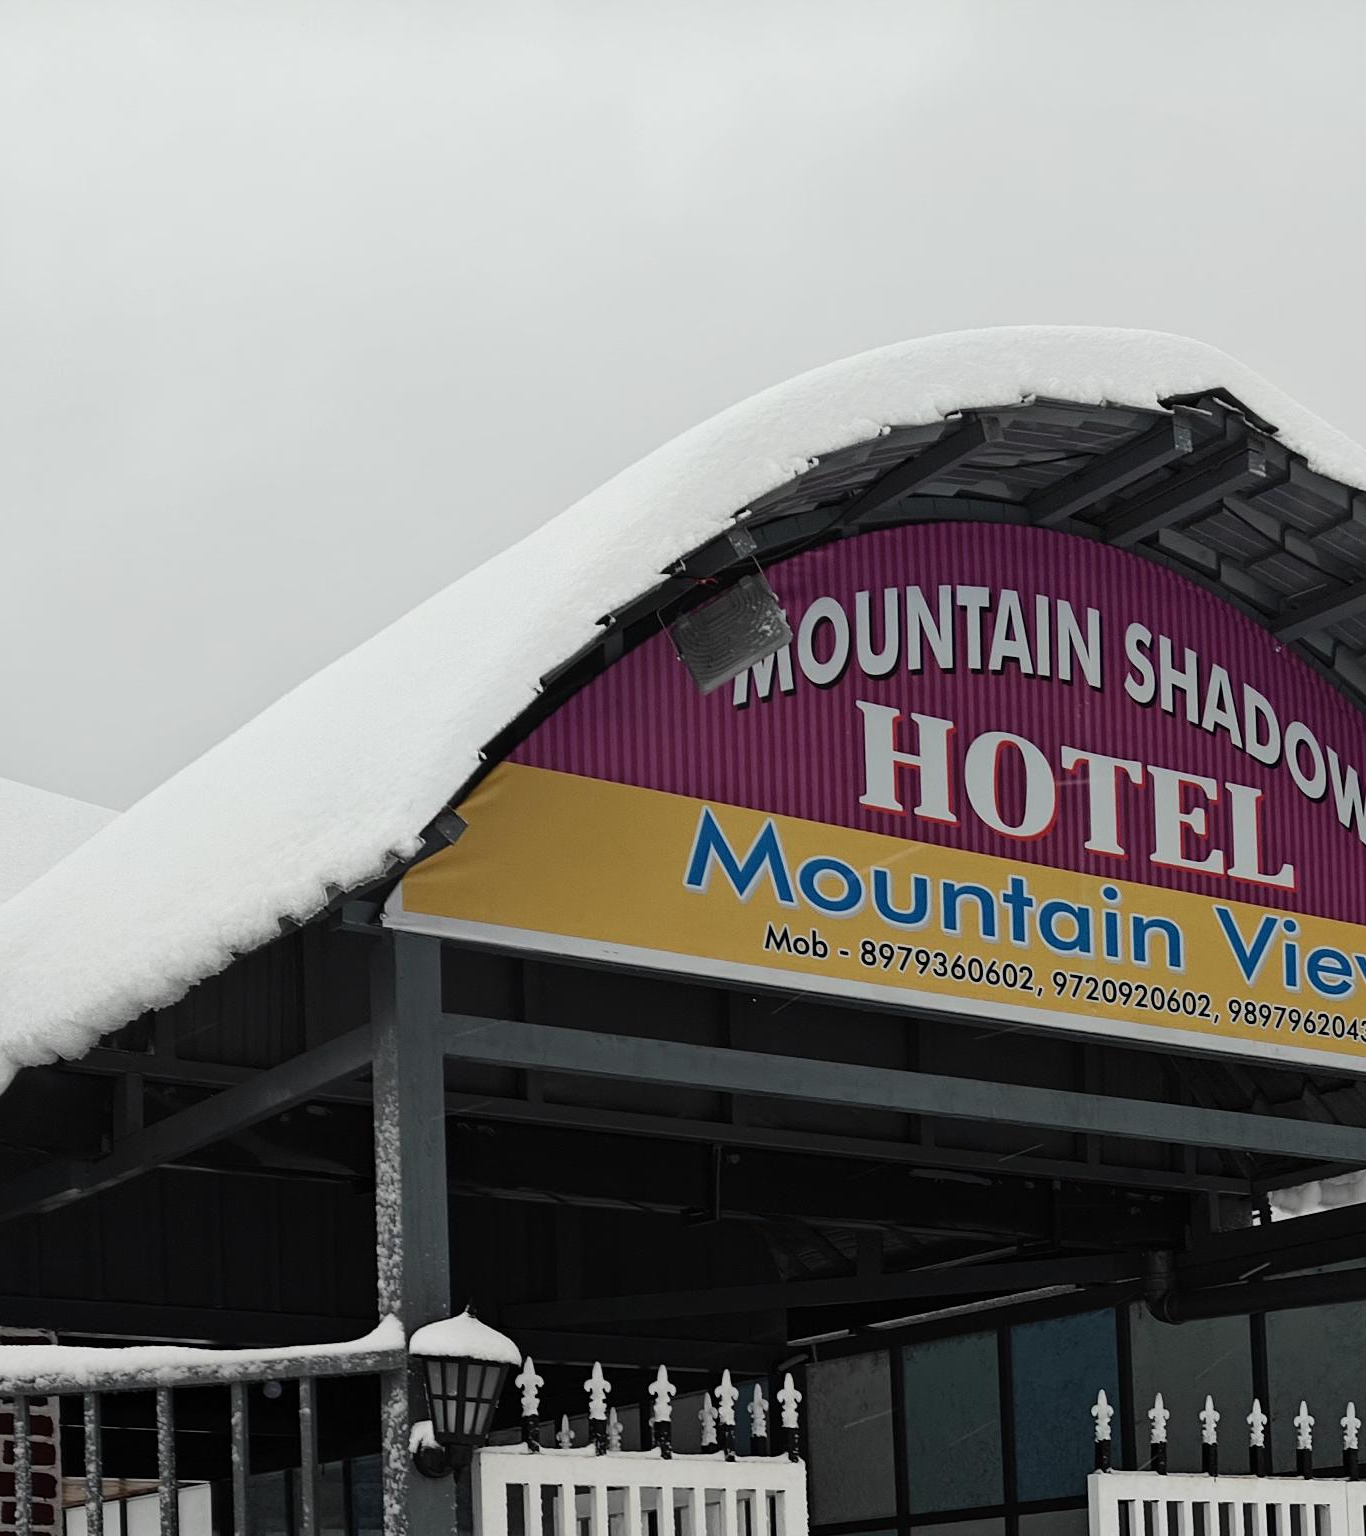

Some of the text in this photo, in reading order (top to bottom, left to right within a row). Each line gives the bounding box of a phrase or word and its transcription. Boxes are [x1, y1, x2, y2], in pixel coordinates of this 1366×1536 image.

[856, 700, 1295, 892] HOTEL
[685, 808, 1184, 969] Mountain
[764, 923, 828, 958] Mob
[861, 941, 1043, 997] 8979360602,
[1052, 970, 1220, 1024] 9720920602,
